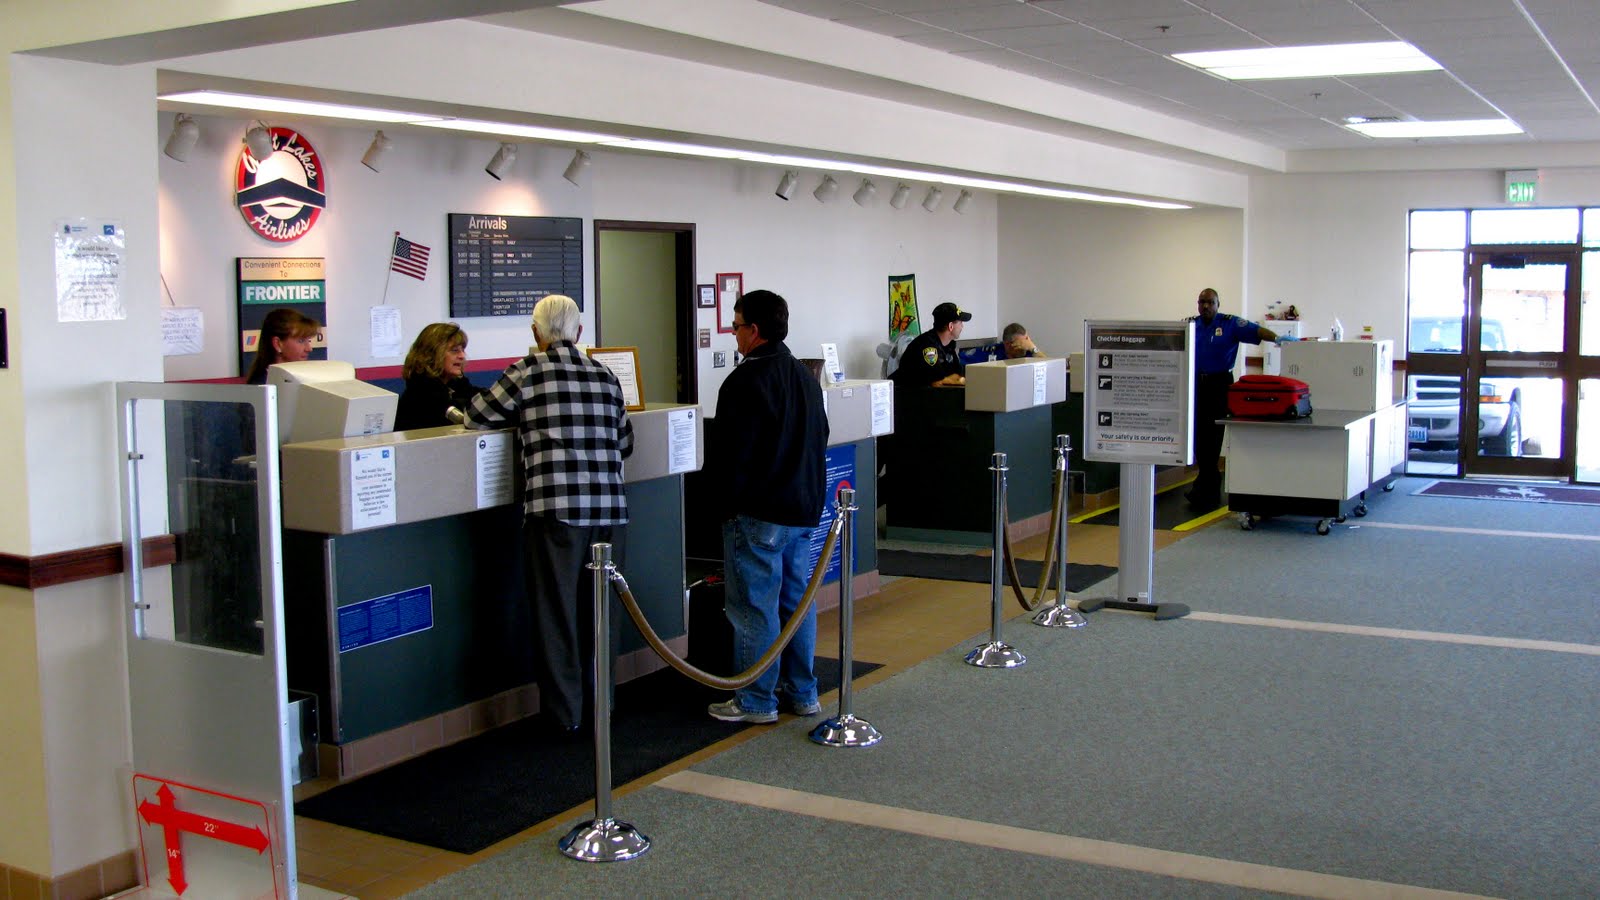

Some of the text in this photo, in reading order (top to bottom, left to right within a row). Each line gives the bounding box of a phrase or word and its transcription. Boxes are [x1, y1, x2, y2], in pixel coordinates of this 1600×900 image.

[281, 132, 318, 180] Lakes
[1508, 182, 1535, 202] EXIT
[251, 213, 311, 240] Airlines
[468, 215, 508, 230] Arrivals
[244, 260, 321, 269] Convenient Connections
[280, 270, 288, 278] To
[245, 285, 321, 301] FRONTIER
